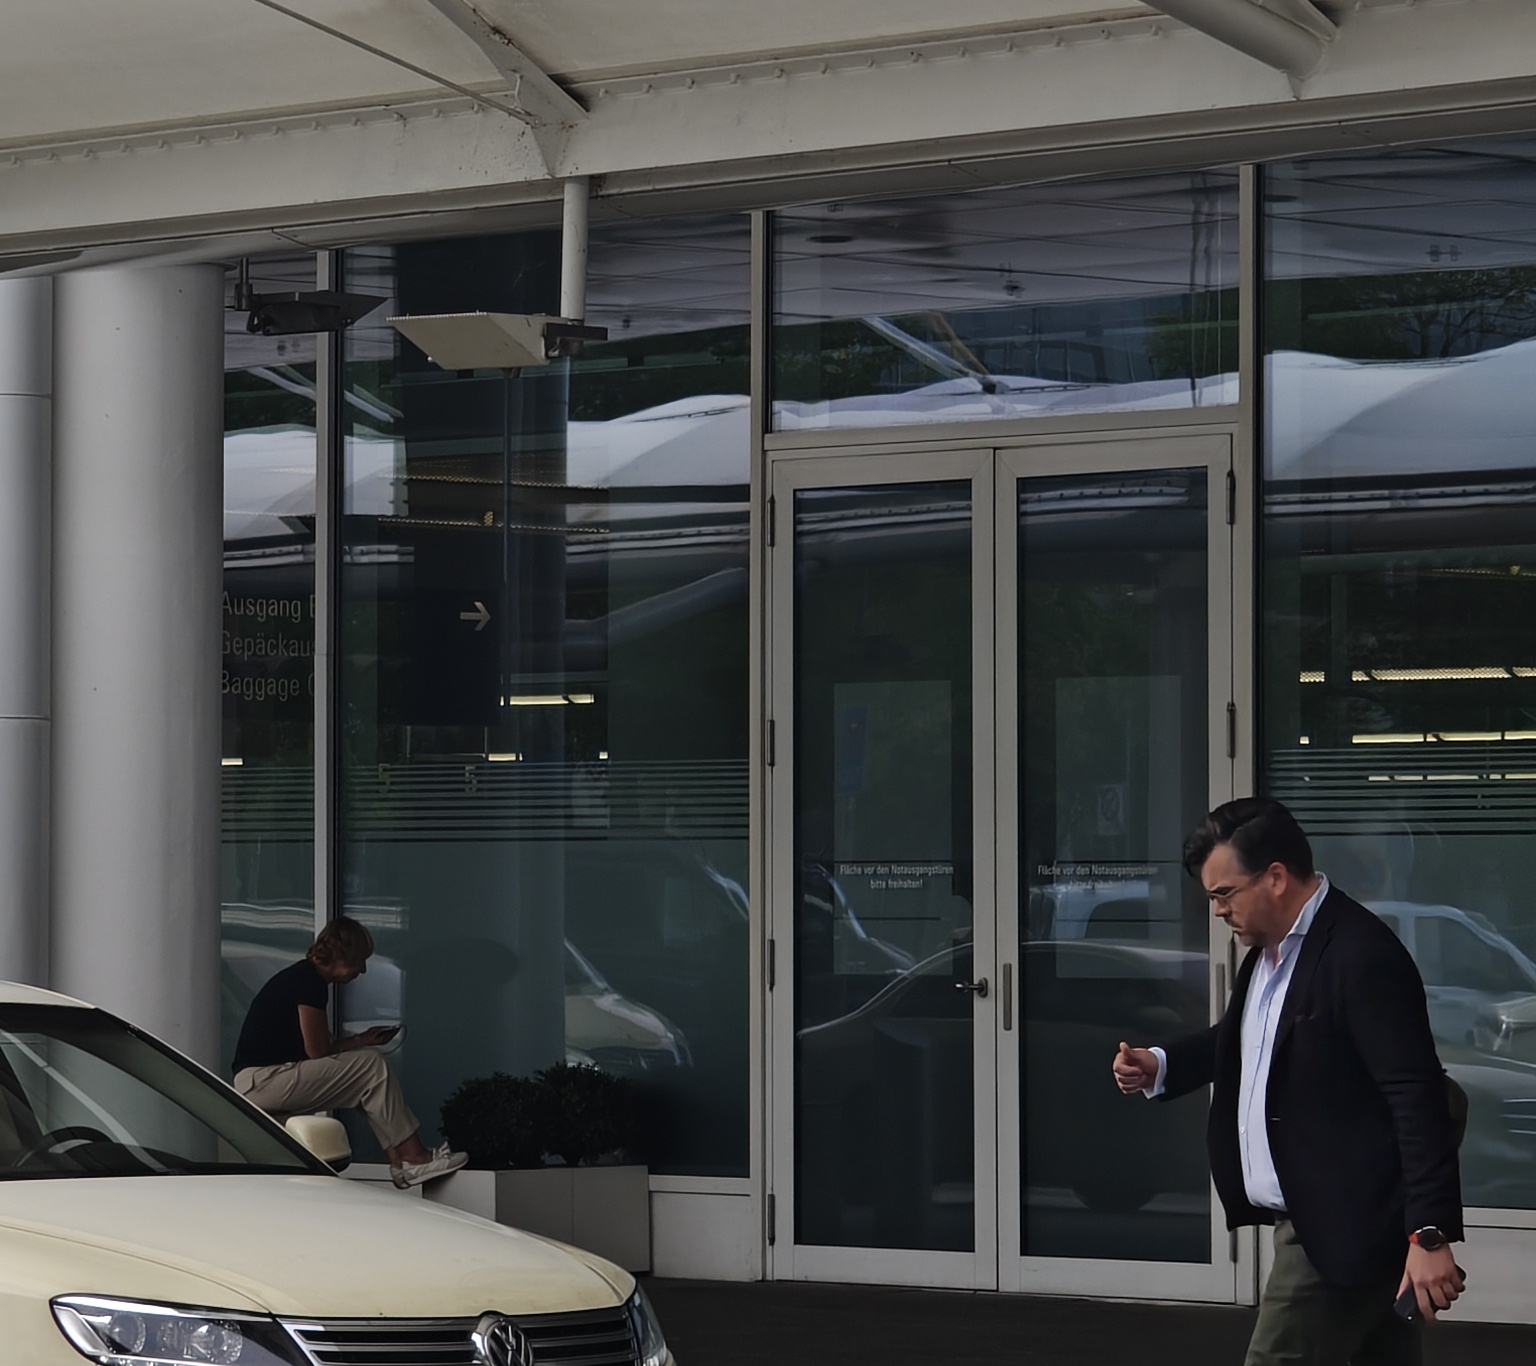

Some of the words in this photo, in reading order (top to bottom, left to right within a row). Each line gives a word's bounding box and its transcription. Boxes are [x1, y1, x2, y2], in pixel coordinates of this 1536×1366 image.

[222, 590, 301, 623] Ausgang
[222, 630, 315, 661] Gepäckau
[222, 670, 300, 701] Baggage
